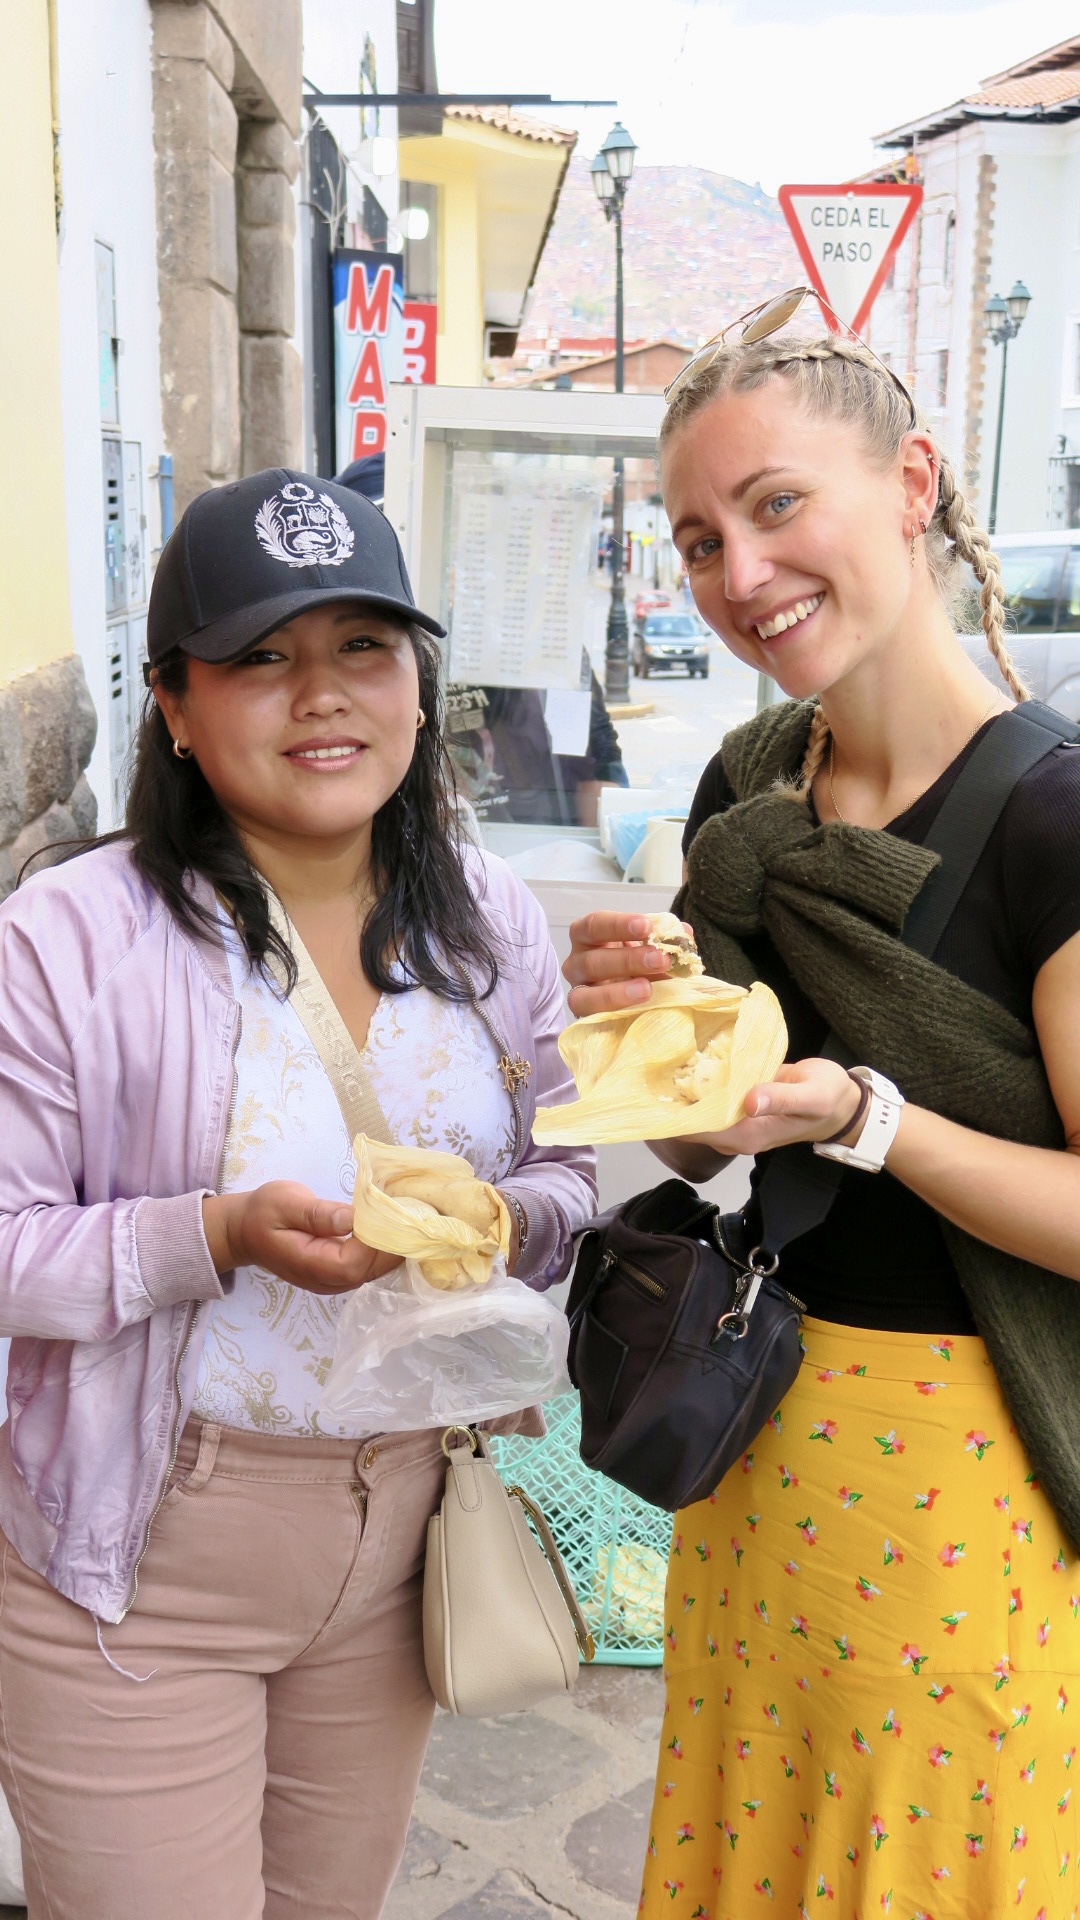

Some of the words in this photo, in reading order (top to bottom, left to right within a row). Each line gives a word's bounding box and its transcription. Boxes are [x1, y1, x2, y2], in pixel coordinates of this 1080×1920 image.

[811, 206, 862, 228] CEDA
[868, 208, 890, 228] EL
[822, 242, 872, 262] PASO
